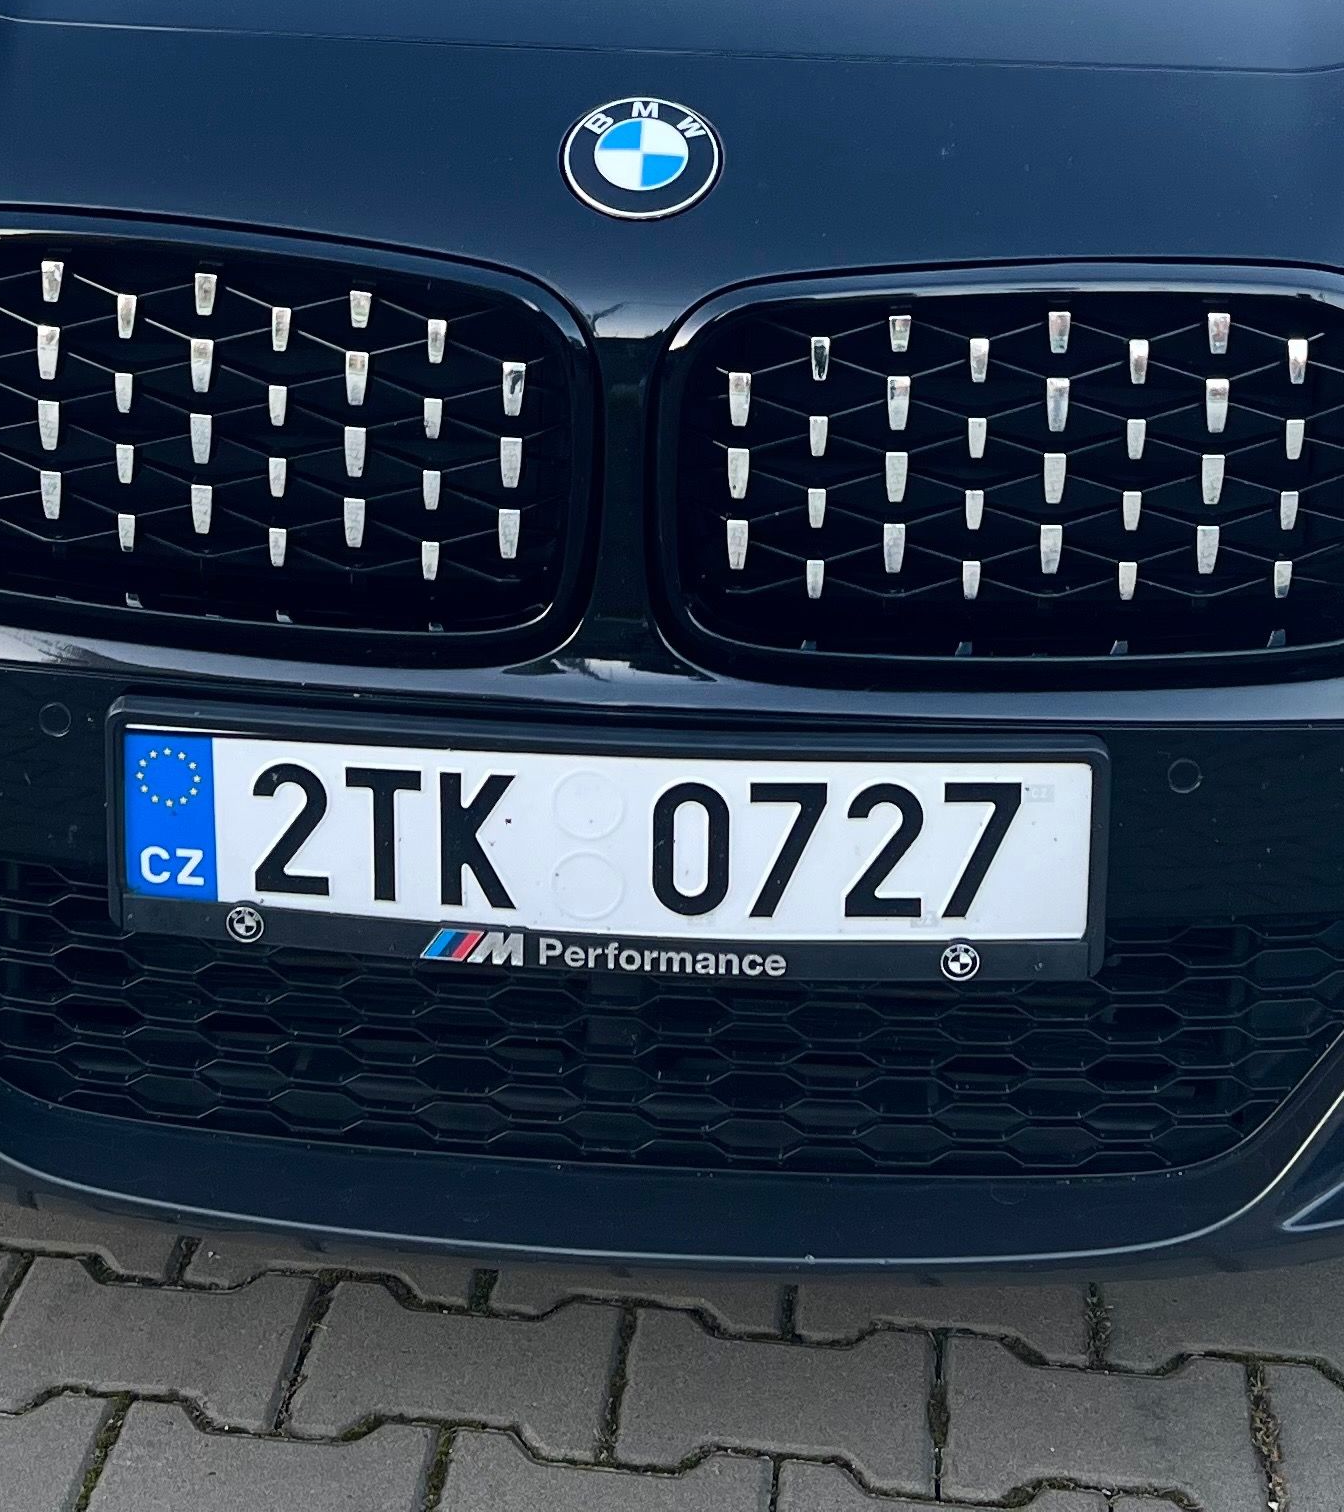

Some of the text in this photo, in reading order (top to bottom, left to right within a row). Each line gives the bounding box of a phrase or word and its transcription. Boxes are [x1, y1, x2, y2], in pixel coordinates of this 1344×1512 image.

[583, 101, 707, 139] BMW
[139, 762, 1023, 919] CZ 2TK 0727
[538, 937, 788, 977] Performance
